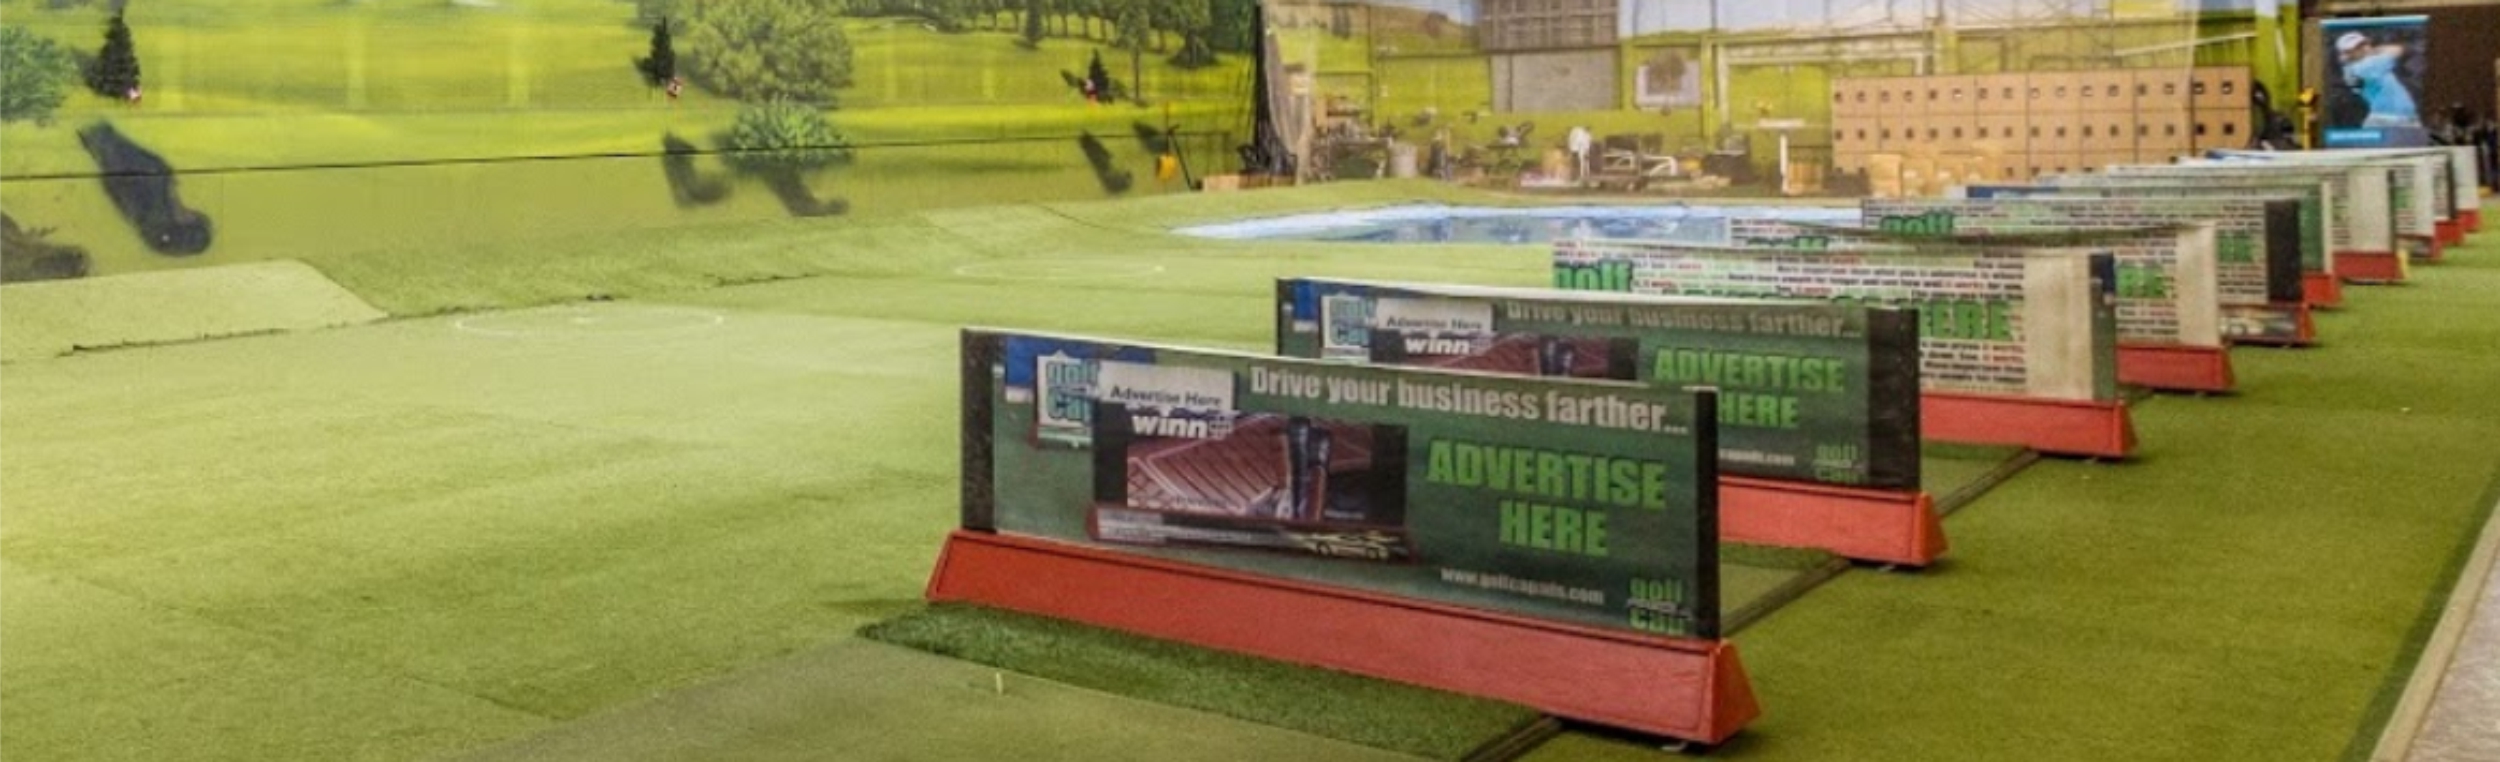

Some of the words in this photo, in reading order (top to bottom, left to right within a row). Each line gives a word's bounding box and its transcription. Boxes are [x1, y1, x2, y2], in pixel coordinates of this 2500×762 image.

[1506, 301, 1565, 322] Drive
[1570, 306, 1622, 326] your
[1628, 306, 1744, 331] business
[1110, 385, 1181, 403] Advertise
[1251, 365, 1321, 398] Drive
[1327, 376, 1391, 406] your
[1398, 378, 1540, 420] business
[1653, 348, 1846, 393] ADVERTISE
[1427, 438, 1667, 511] ADVERTISE
[1500, 499, 1608, 556] HERE
